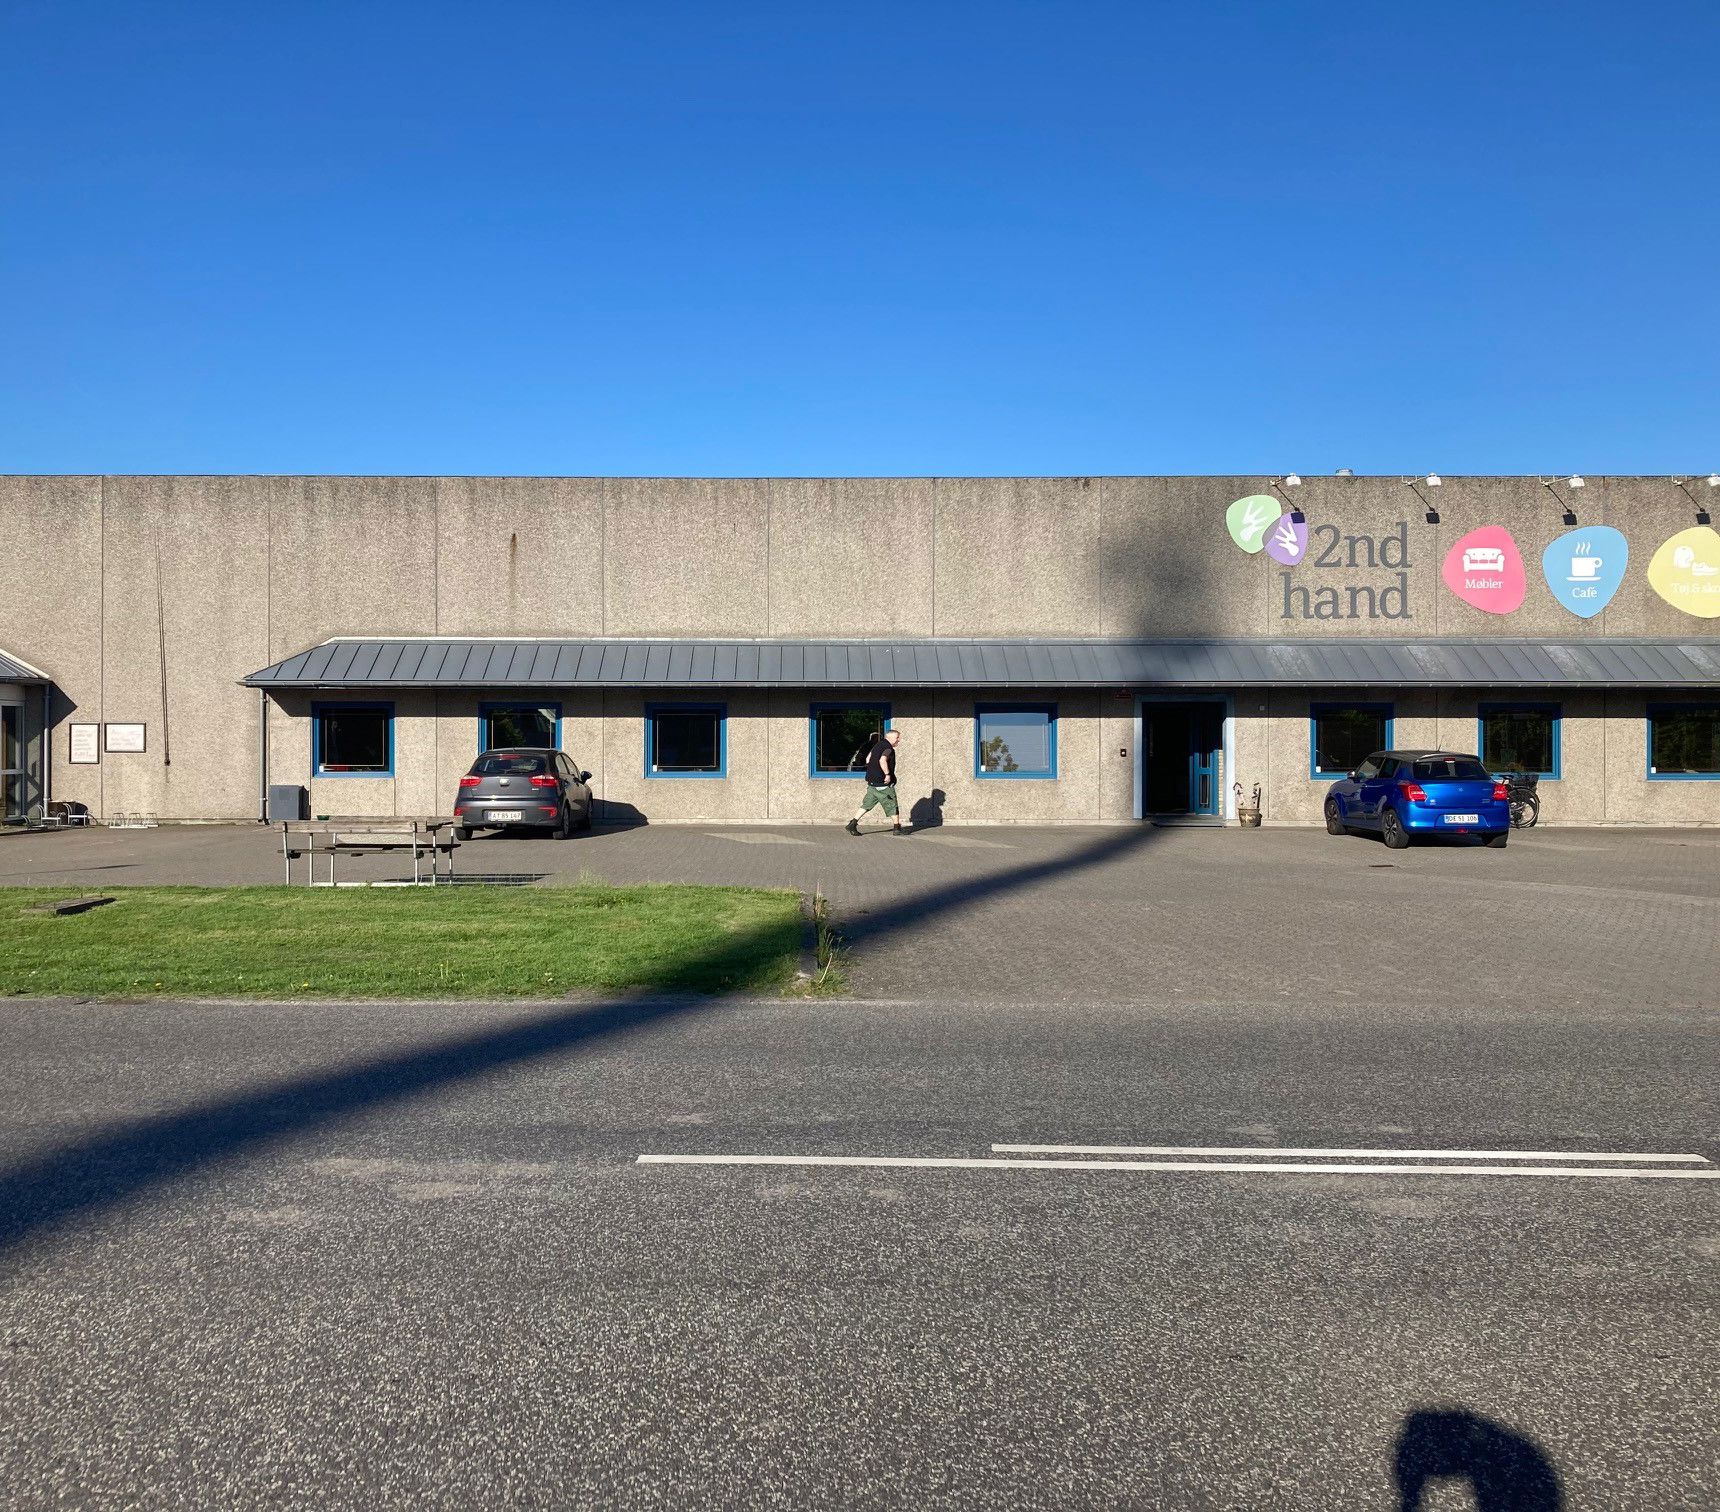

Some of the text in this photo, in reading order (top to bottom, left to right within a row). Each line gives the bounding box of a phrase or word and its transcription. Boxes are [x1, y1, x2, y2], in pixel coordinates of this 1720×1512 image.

[1314, 521, 1413, 569] 2nd
[1280, 571, 1413, 620] hand
[1464, 577, 1504, 589] Møbler
[1572, 586, 1598, 598] Café
